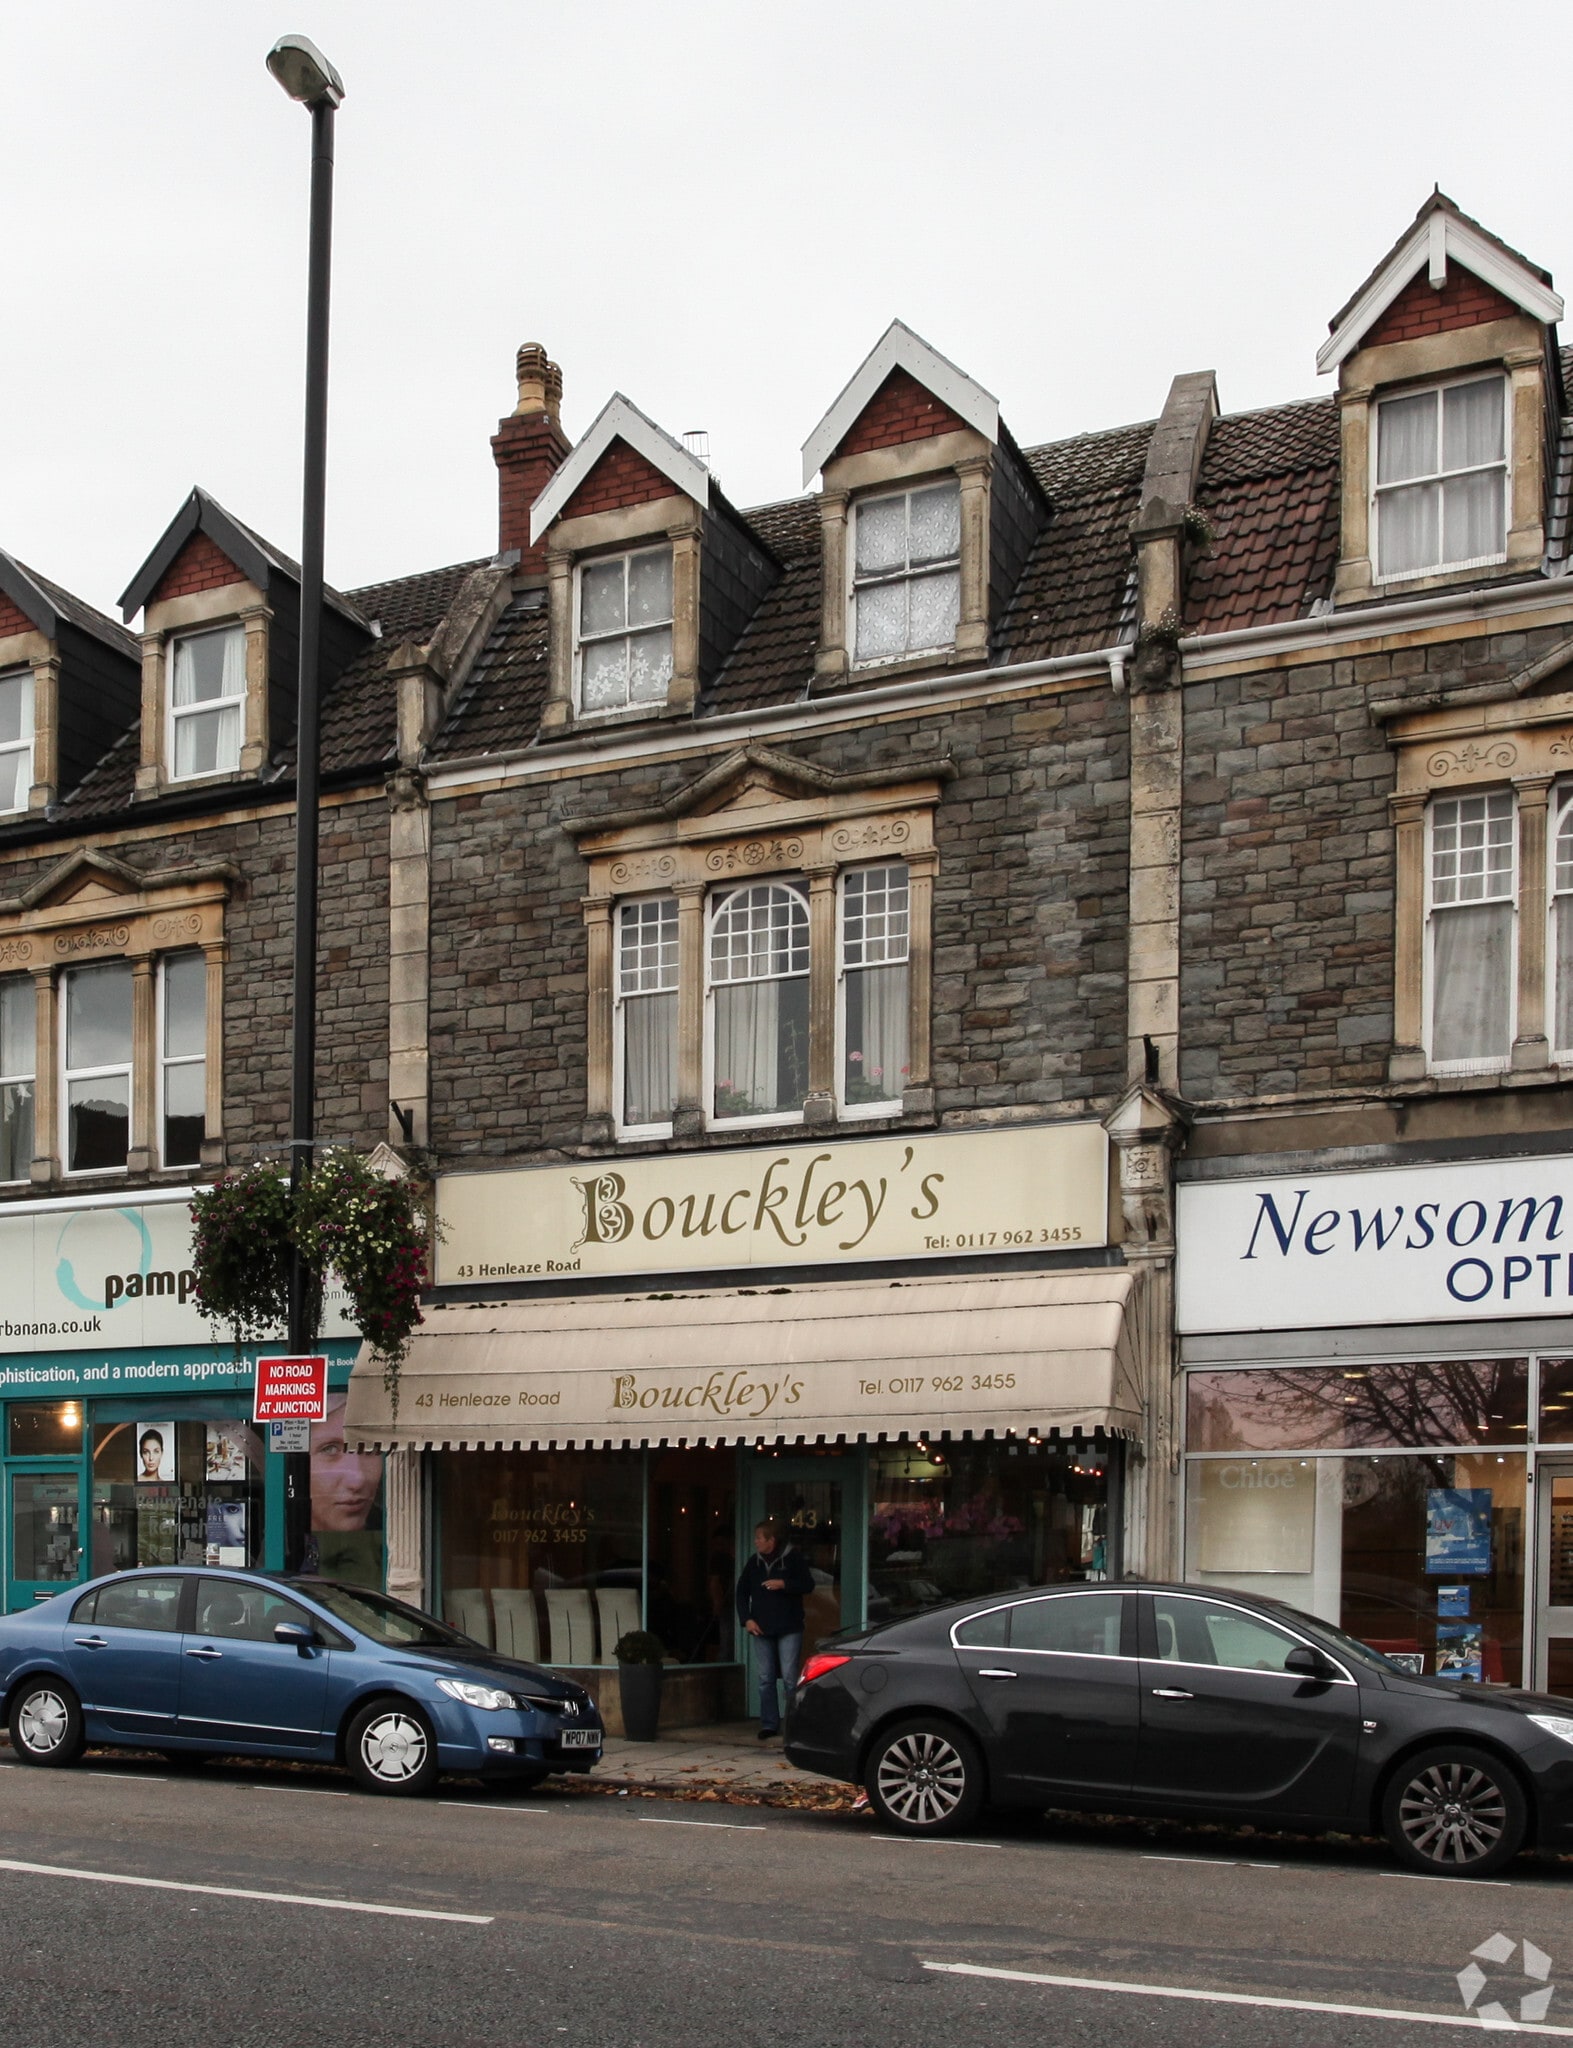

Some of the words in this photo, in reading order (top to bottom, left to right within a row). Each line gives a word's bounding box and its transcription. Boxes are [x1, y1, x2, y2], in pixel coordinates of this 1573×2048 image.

[569, 1146, 945, 1255] Bouckley's
[924, 1235, 951, 1250] Tel:
[956, 1231, 997, 1248] 0117
[1003, 1229, 1034, 1245] 962
[1040, 1226, 1083, 1244] 3455
[457, 1264, 474, 1278] 43
[479, 1261, 542, 1277] Henleaze
[546, 1258, 582, 1273] Road
[104, 1269, 199, 1309] pamp
[83, 1362, 109, 1380] and
[112, 1367, 121, 1379] a
[125, 1361, 180, 1379] modern
[183, 1356, 252, 1381] approach
[269, 1366, 284, 1378] NO
[285, 1365, 313, 1378] ROAD
[265, 1382, 316, 1396] MARKINGS
[611, 1370, 805, 1418] Bouckley's
[859, 1378, 884, 1395] Tel.
[931, 1376, 964, 1392] 962
[971, 1373, 1017, 1391] 3455
[259, 1401, 272, 1414] AT
[272, 1400, 321, 1413] JUNCTION
[415, 1394, 434, 1408] 43
[439, 1392, 511, 1408] Henleaze
[518, 1391, 561, 1406] Road
[492, 1529, 519, 1543] 0117
[524, 1529, 548, 1543] 962
[552, 1528, 588, 1543] 3455
